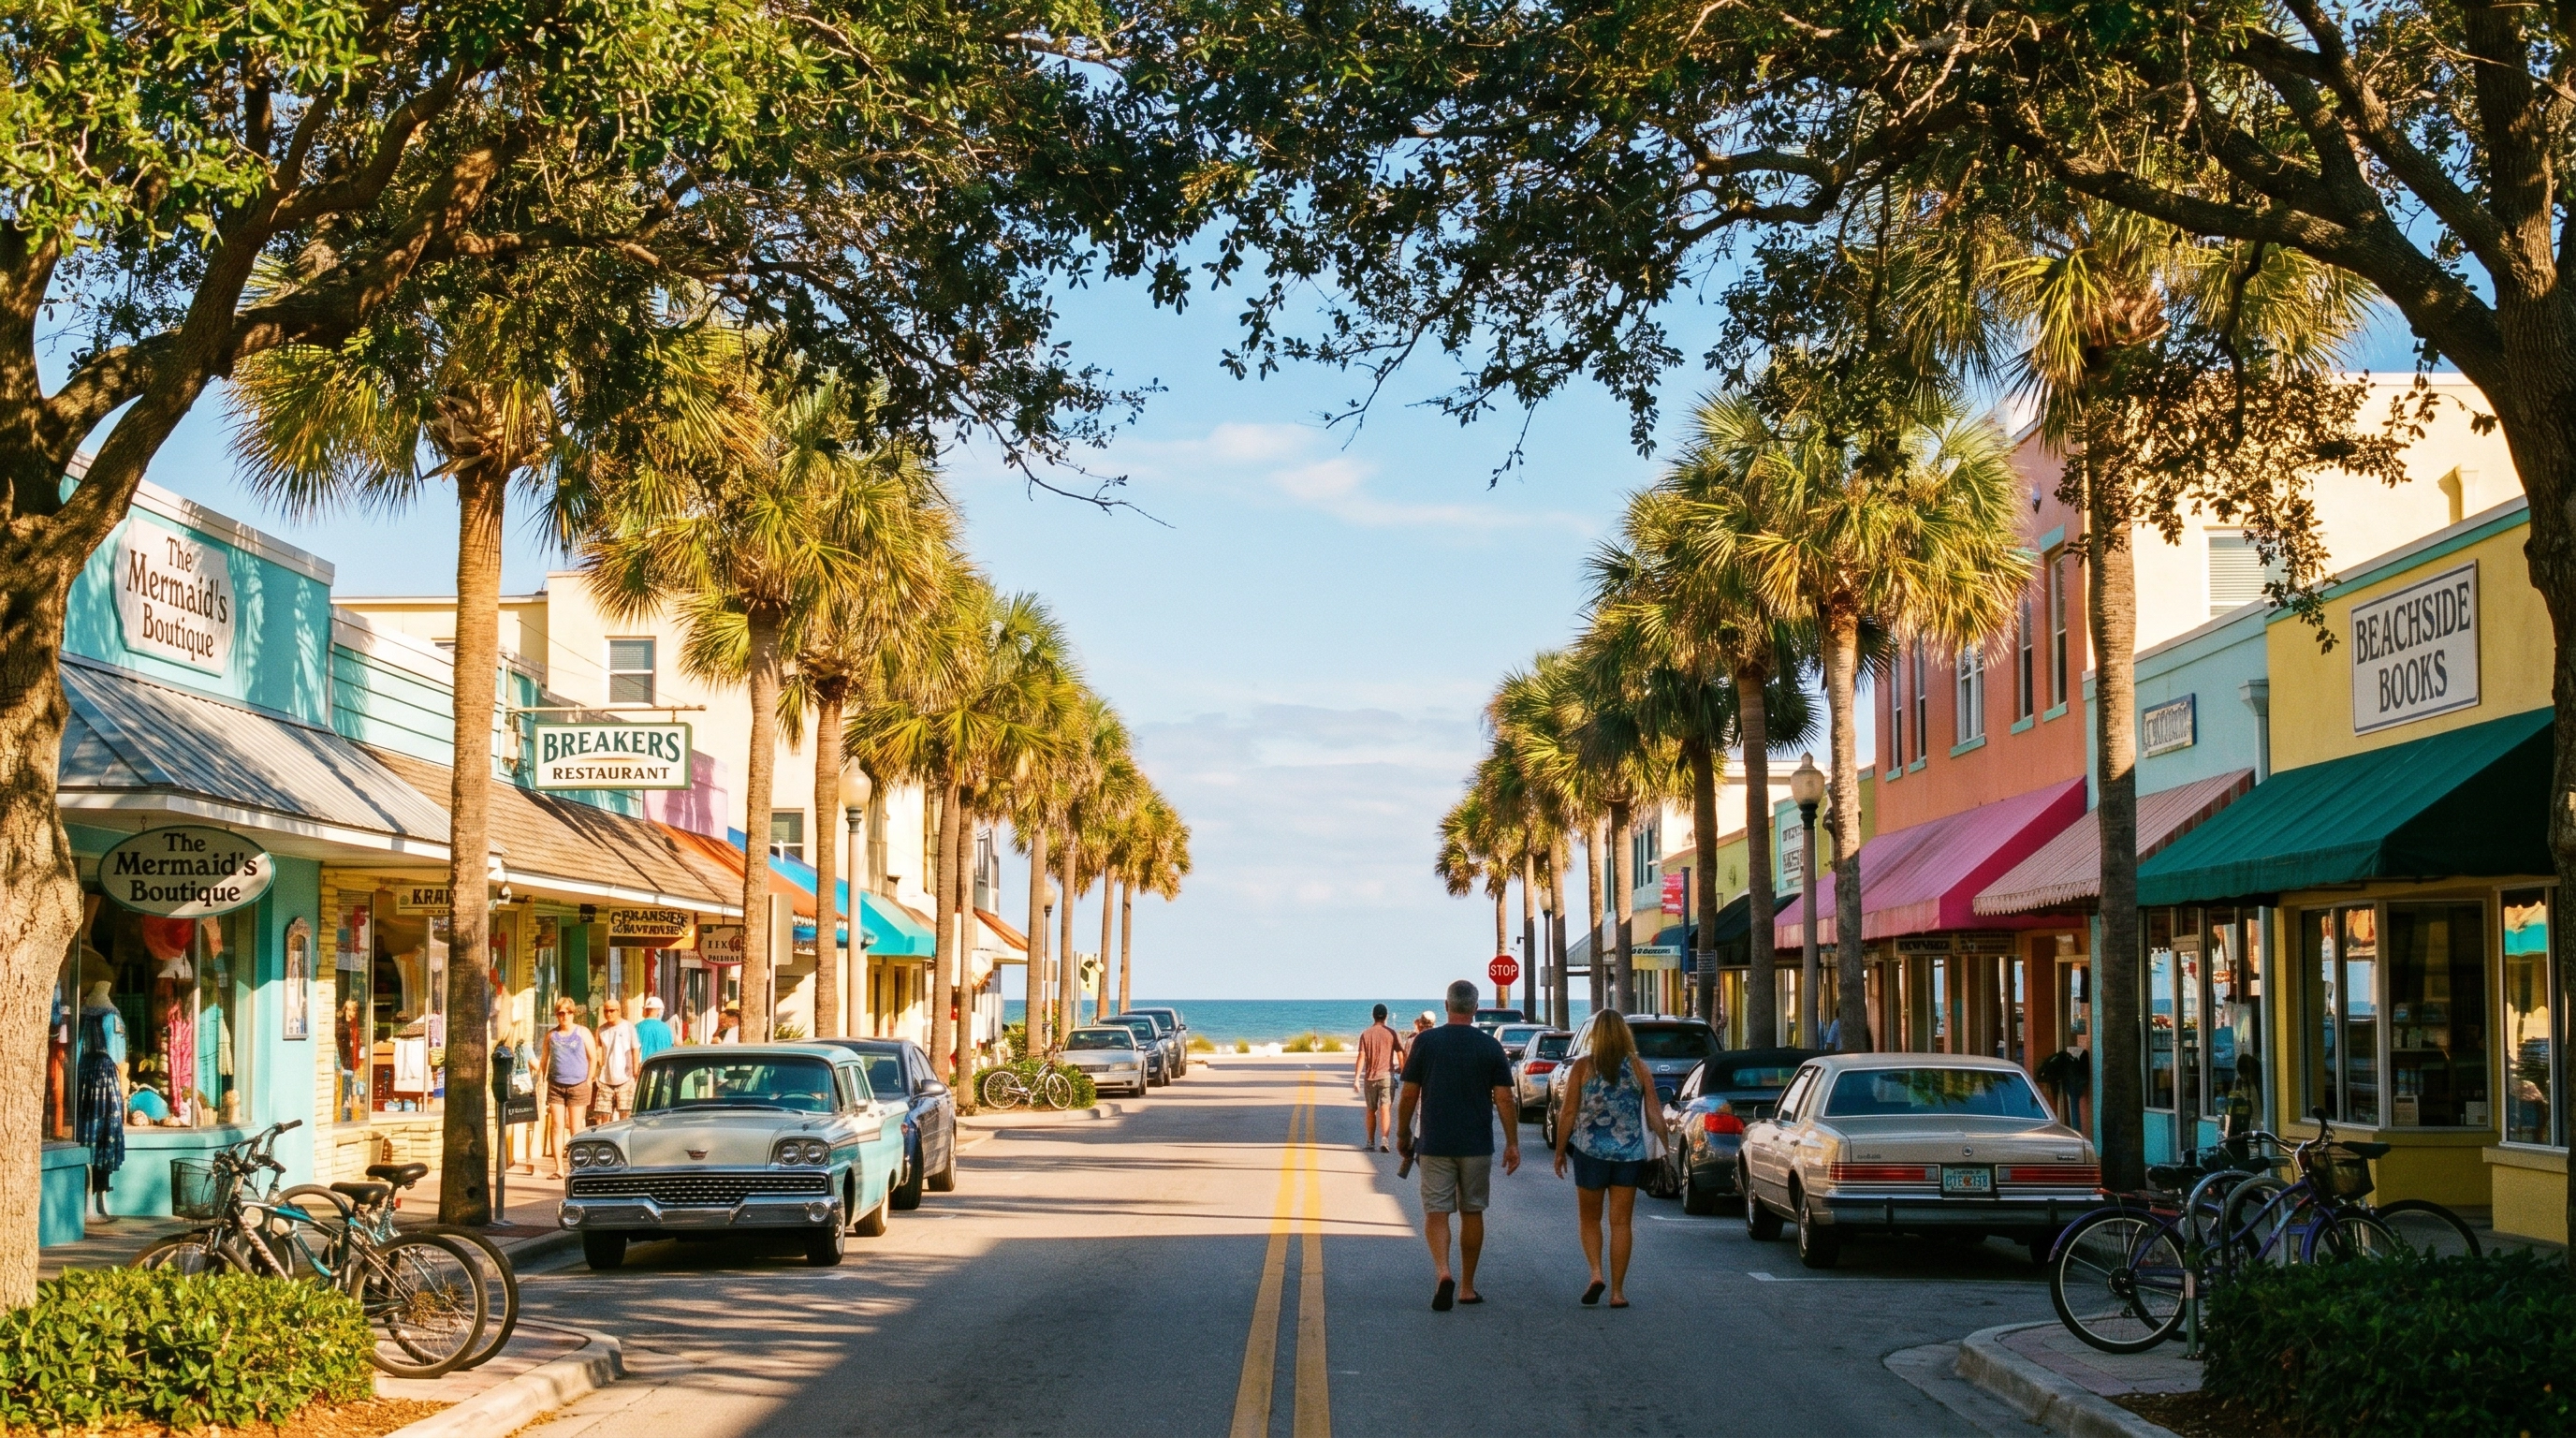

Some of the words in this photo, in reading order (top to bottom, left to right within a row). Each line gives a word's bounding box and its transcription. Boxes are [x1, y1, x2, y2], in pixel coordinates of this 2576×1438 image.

[167, 536, 192, 573] The
[126, 549, 227, 624] Mermaid's
[142, 602, 214, 661] Boutique
[2355, 580, 2471, 666] BEACHSIDE
[2378, 649, 2448, 713] BOOKS
[543, 731, 681, 764] BREAKERS
[552, 767, 670, 780] RESTAURANT
[163, 833, 206, 852] The
[113, 852, 257, 876] Mermaid's
[129, 880, 241, 907] Boutique
[1490, 964, 1517, 976] STOP
